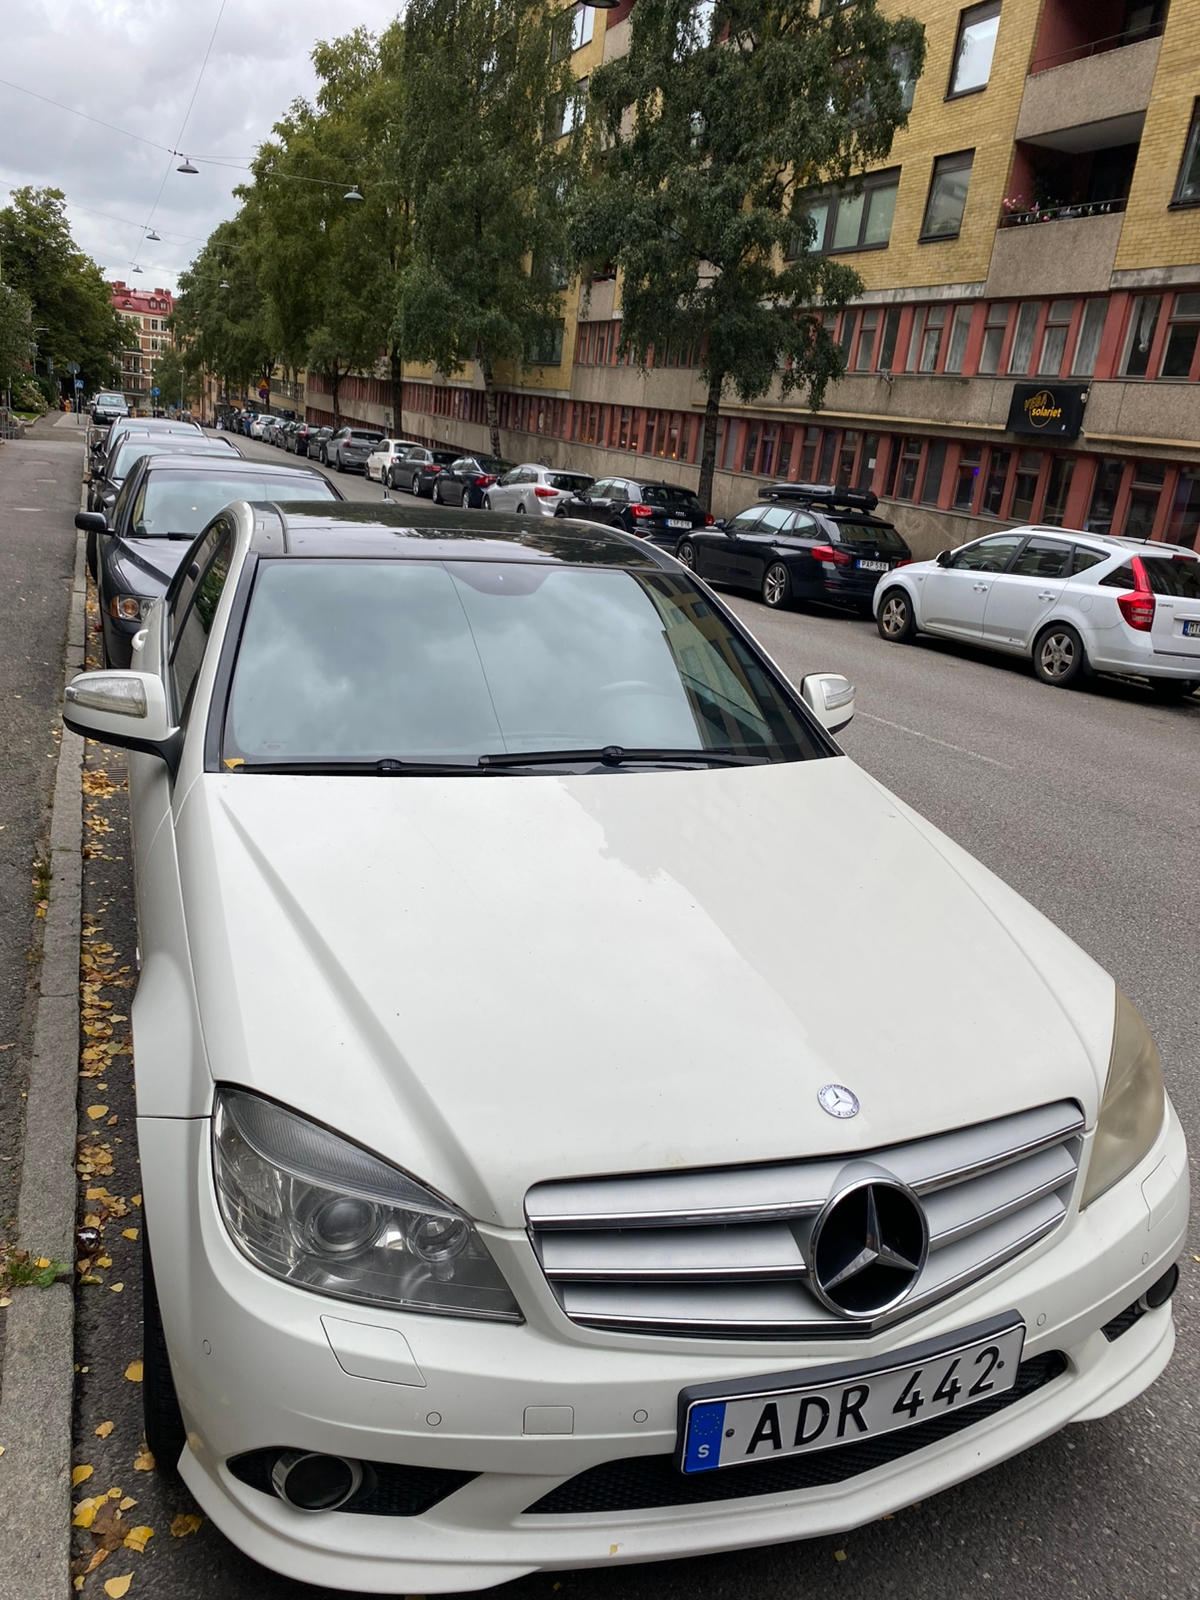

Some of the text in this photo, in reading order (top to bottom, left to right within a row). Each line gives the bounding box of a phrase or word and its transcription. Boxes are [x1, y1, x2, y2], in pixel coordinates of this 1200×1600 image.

[1031, 405, 1062, 417] solariet
[861, 560, 887, 570] PAP 588
[745, 1345, 1000, 1455] ADR 442
[697, 1444, 710, 1458] S
